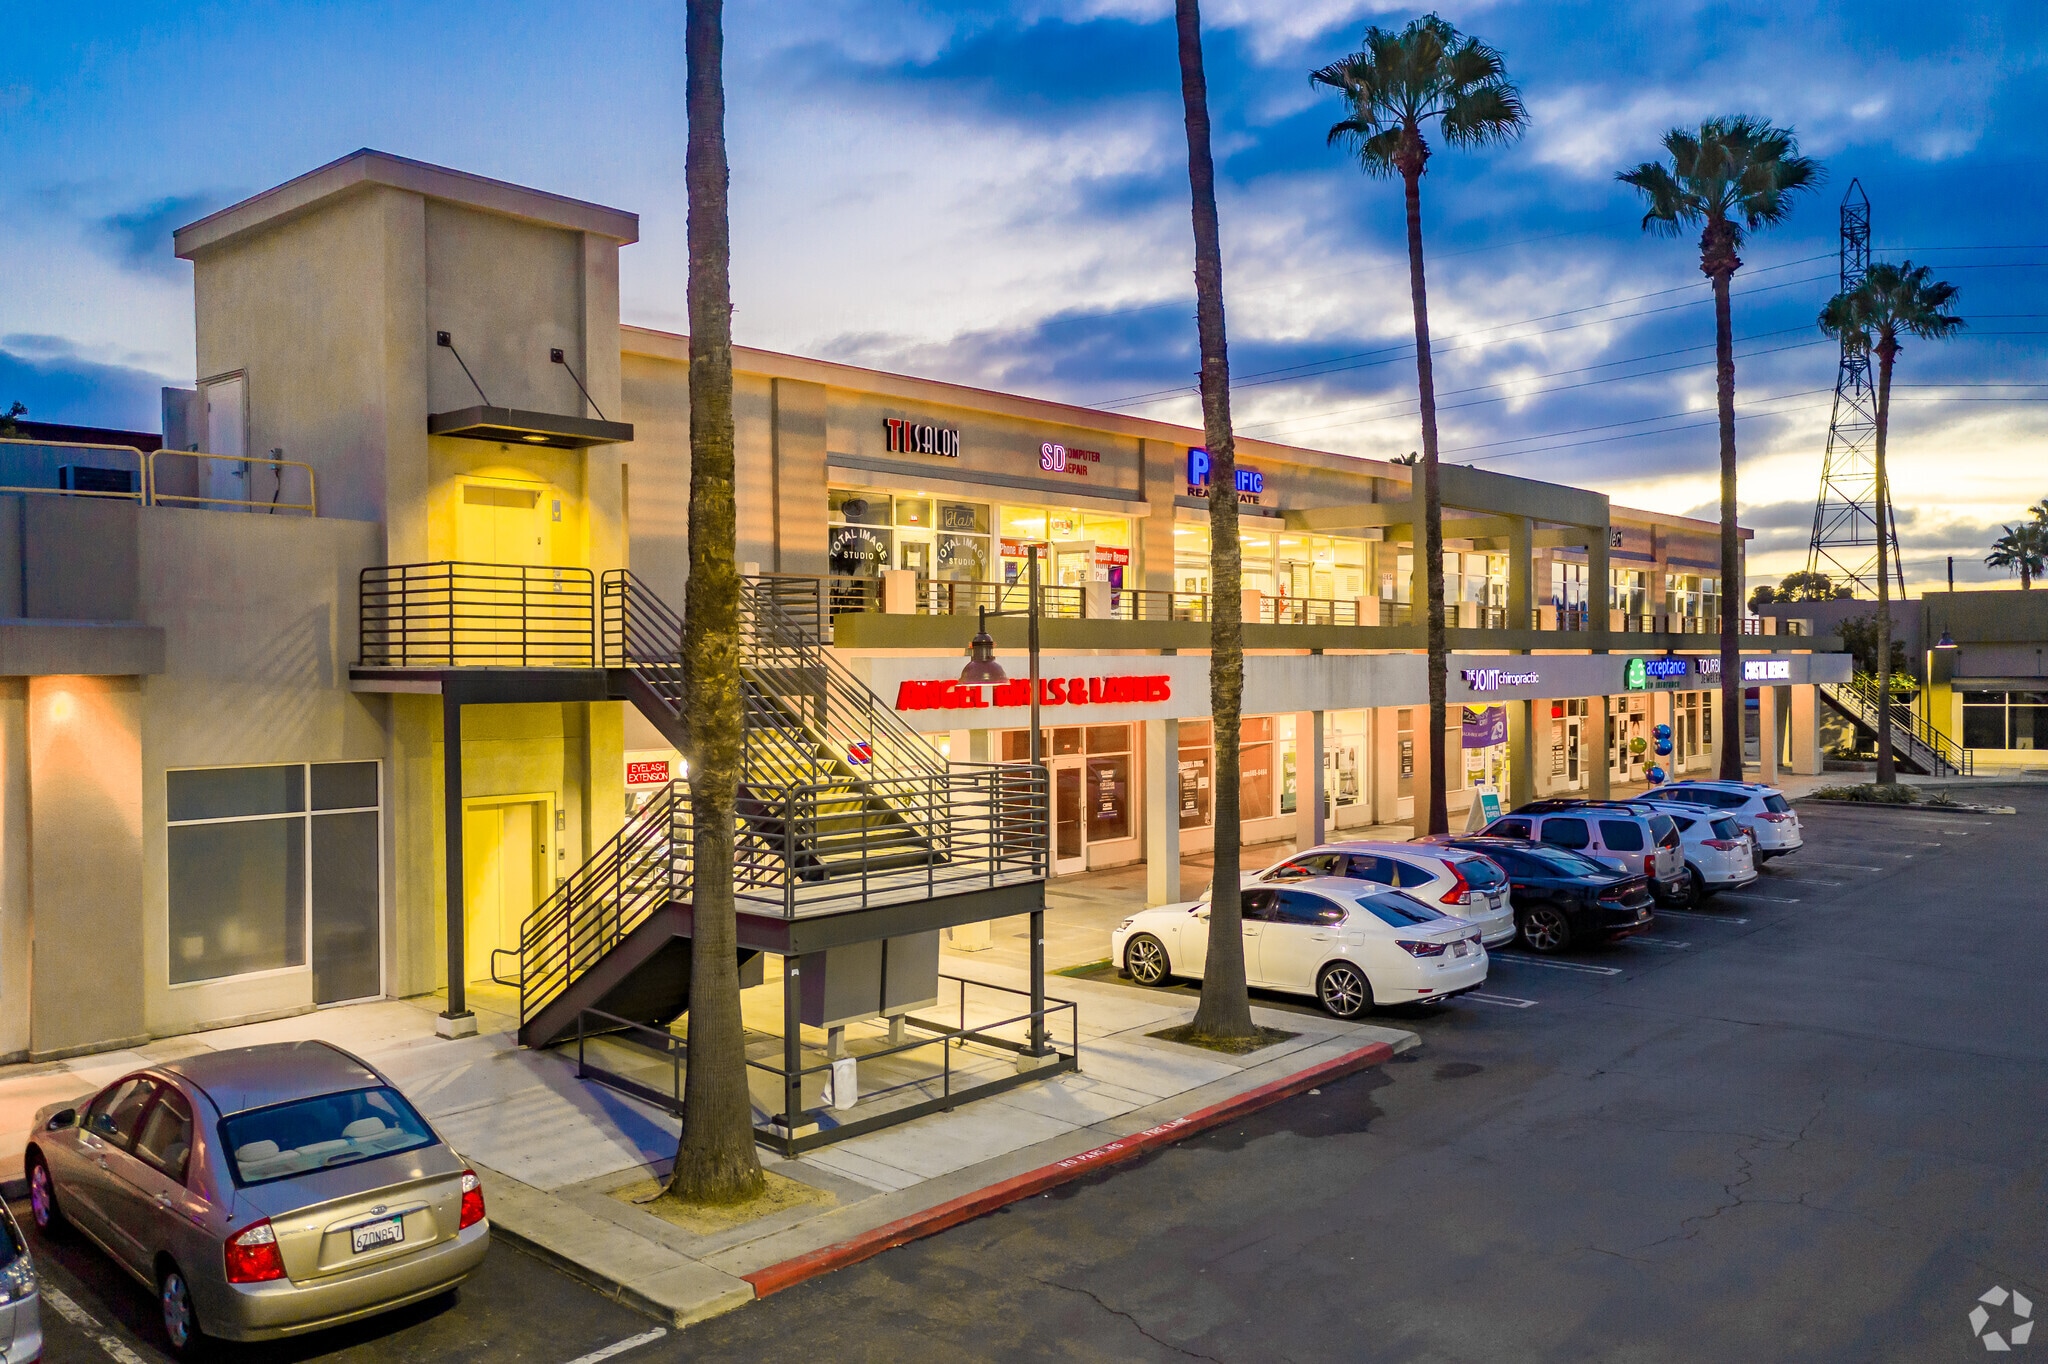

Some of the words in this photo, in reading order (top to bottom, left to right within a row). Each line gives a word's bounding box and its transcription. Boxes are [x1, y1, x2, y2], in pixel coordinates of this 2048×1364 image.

[887, 417, 911, 454] TI
[915, 424, 960, 457] SALON
[1041, 442, 1066, 472] SD
[1188, 447, 1263, 493] PIFIC
[1187, 486, 1210, 498] REA
[947, 511, 974, 528] Hair
[830, 529, 858, 558] TOTAL
[859, 530, 888, 561] IMAGE
[843, 551, 874, 561] STUDIO
[937, 537, 961, 564] TOTAL
[962, 538, 987, 567] IMAGE
[948, 557, 976, 567] STUDIO
[1473, 669, 1500, 691] JOINT
[1499, 671, 1540, 686] chiropractic
[1646, 658, 1686, 680] acceptance
[993, 678, 1066, 707] NALS
[628, 772, 669, 783] EXTENSION
[631, 763, 666, 773] EYELASH
[1486, 810, 1501, 818] OPEN
[1057, 1159, 1077, 1168] NO
[1141, 1126, 1168, 1137] FIRE
[1164, 1116, 1191, 1128] LANE
